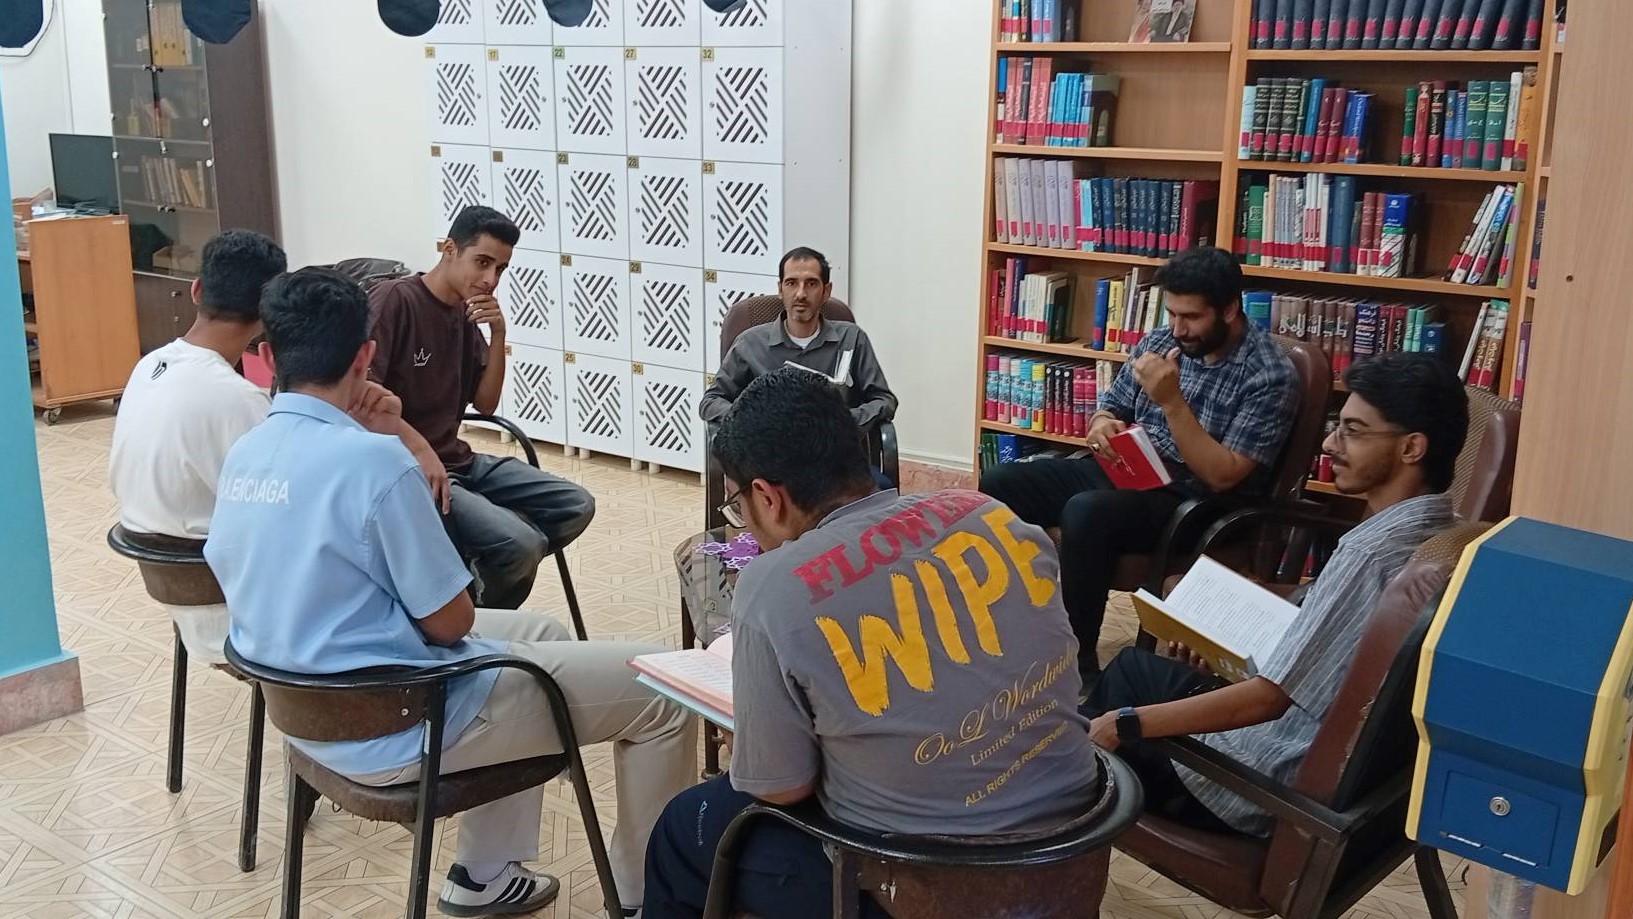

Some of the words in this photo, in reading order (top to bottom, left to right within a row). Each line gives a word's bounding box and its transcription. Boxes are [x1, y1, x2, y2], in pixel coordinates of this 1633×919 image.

[554, 48, 563, 57] 22
[625, 49, 635, 58] 27
[703, 50, 713, 59] 32
[815, 508, 1057, 718] WIPE
[970, 726, 1016, 767] Limited
[1019, 698, 1059, 731] Edition
[965, 789, 987, 807] ALL
[986, 760, 1022, 794] RIGHTS
